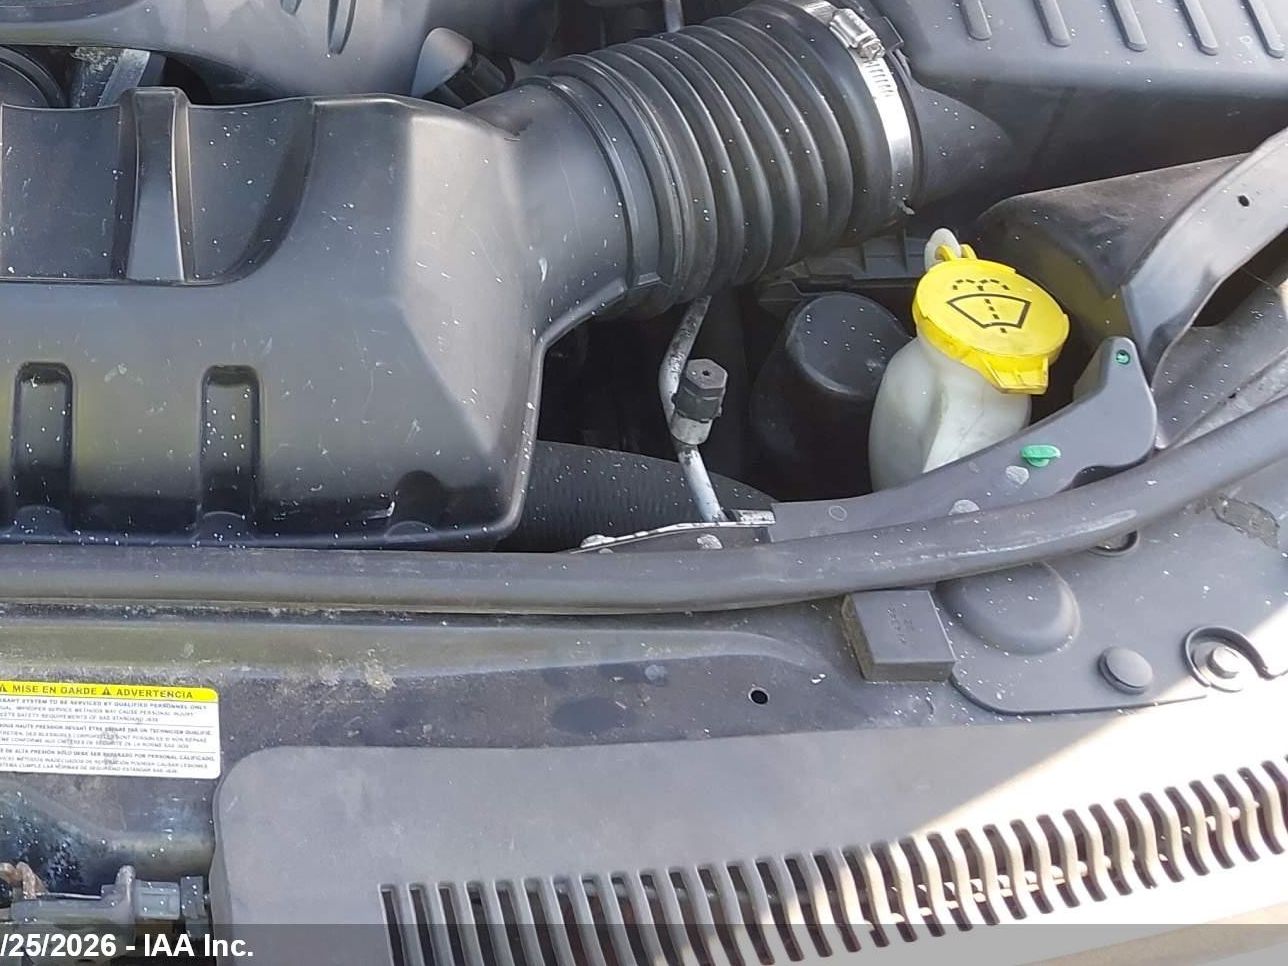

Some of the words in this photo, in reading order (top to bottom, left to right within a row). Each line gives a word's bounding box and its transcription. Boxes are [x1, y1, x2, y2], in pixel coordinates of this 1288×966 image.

[12, 684, 38, 693] MISE
[42, 685, 56, 694] EN
[60, 686, 96, 695] GARDE
[116, 688, 192, 698] ADVERTENCIA
